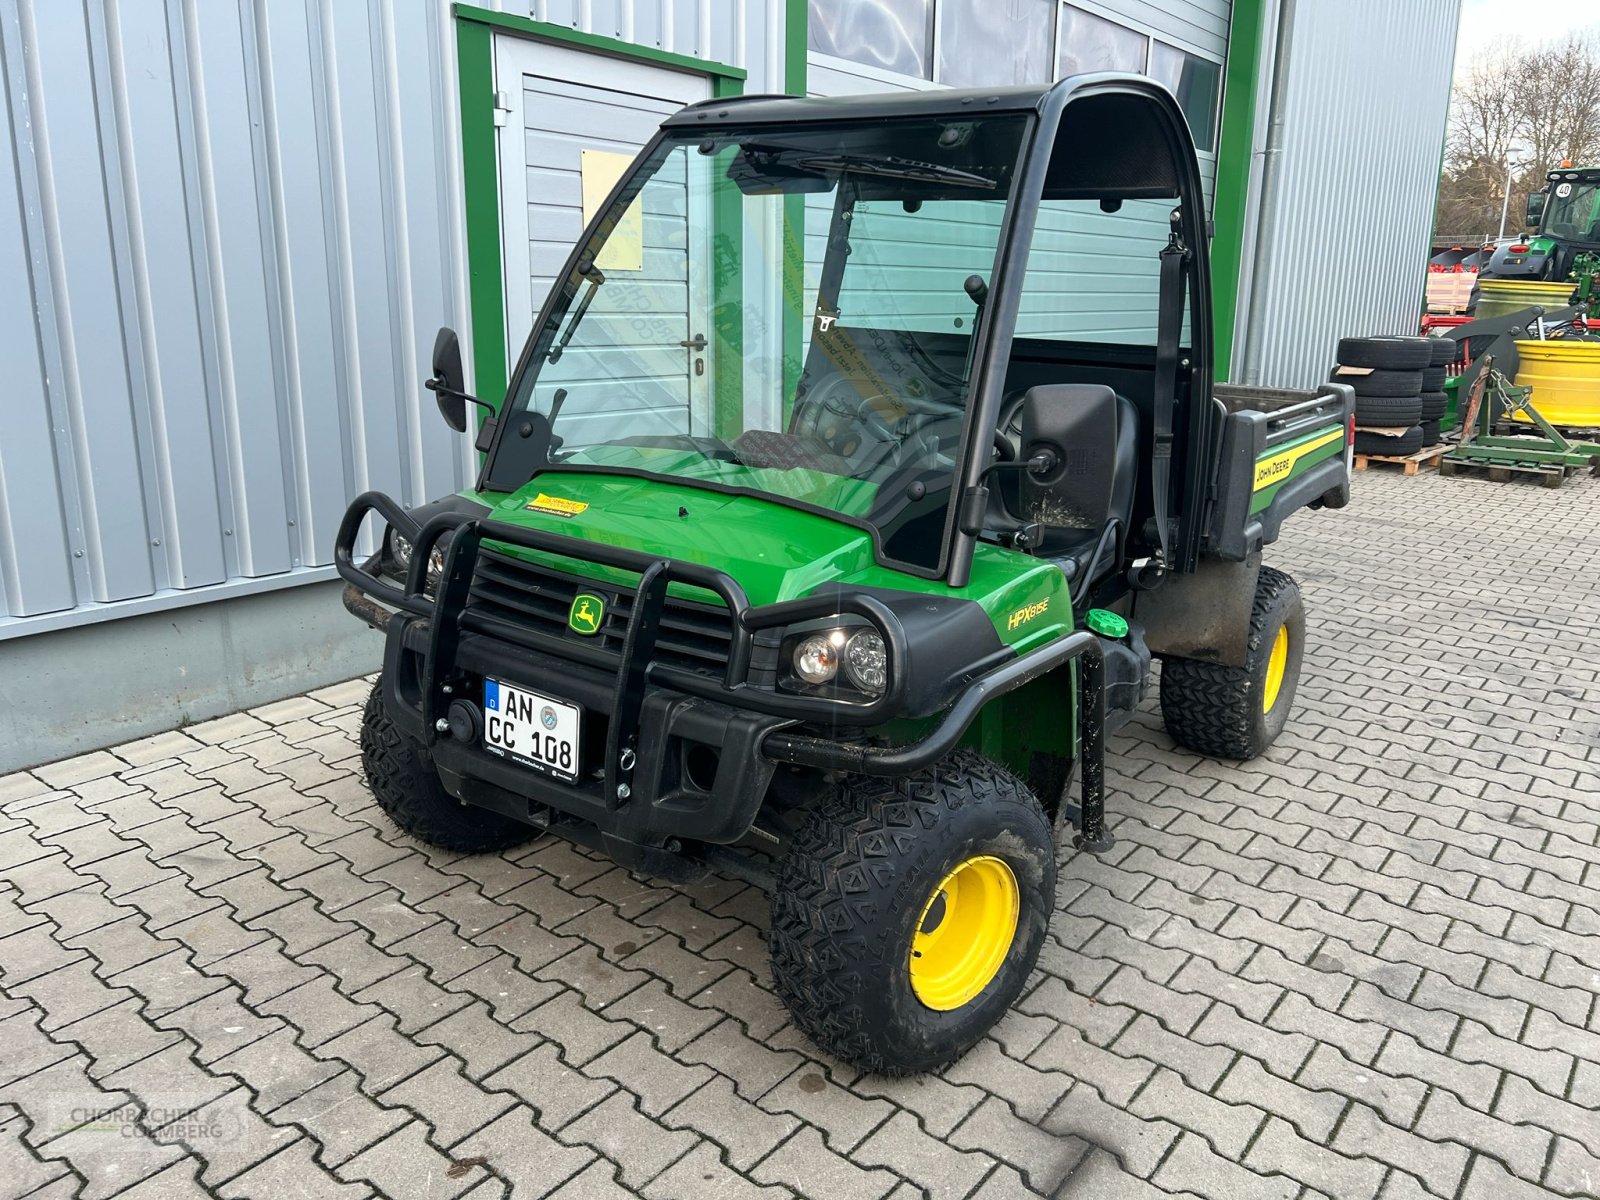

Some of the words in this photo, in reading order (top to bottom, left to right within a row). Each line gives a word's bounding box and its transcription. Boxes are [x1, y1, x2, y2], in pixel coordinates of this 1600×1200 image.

[1559, 185, 1570, 195] 40
[1256, 469, 1272, 482] JOHN
[1271, 458, 1290, 476] DEERE
[1007, 596, 1050, 631] HPX815E
[489, 698, 496, 708] D
[505, 690, 533, 725] AN
[489, 716, 516, 749] CC
[530, 731, 572, 769] 108
